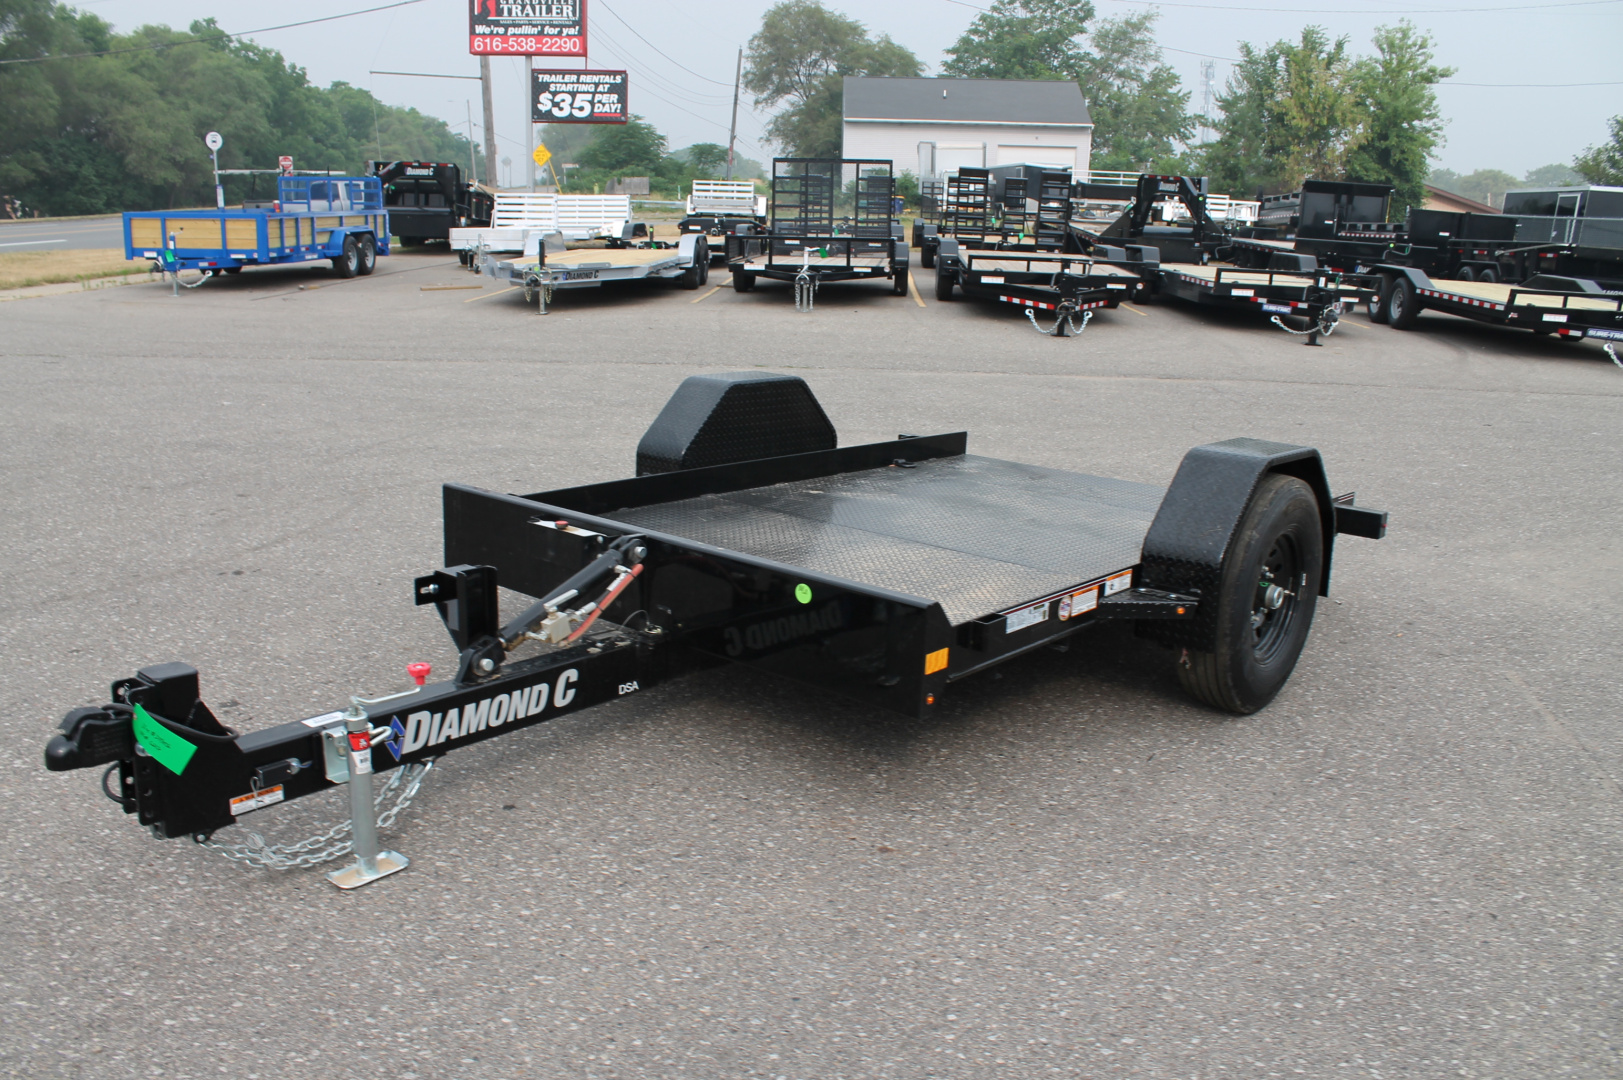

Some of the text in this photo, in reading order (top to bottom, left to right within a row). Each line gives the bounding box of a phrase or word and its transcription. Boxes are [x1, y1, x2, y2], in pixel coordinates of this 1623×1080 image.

[500, 5, 573, 17] TRAILER
[475, 25, 579, 36] We're pullin' for ya!
[474, 37, 579, 51] 616-538-2290
[538, 74, 622, 84] TRAILER RENTALS
[549, 83, 611, 92] STARTING AT
[594, 93, 618, 103] PER
[537, 91, 592, 118] $35
[594, 103, 621, 113] DAY!
[565, 270, 600, 281] DIAMOND C
[618, 680, 639, 695] DSA
[401, 668, 579, 754] DIAMOND C
